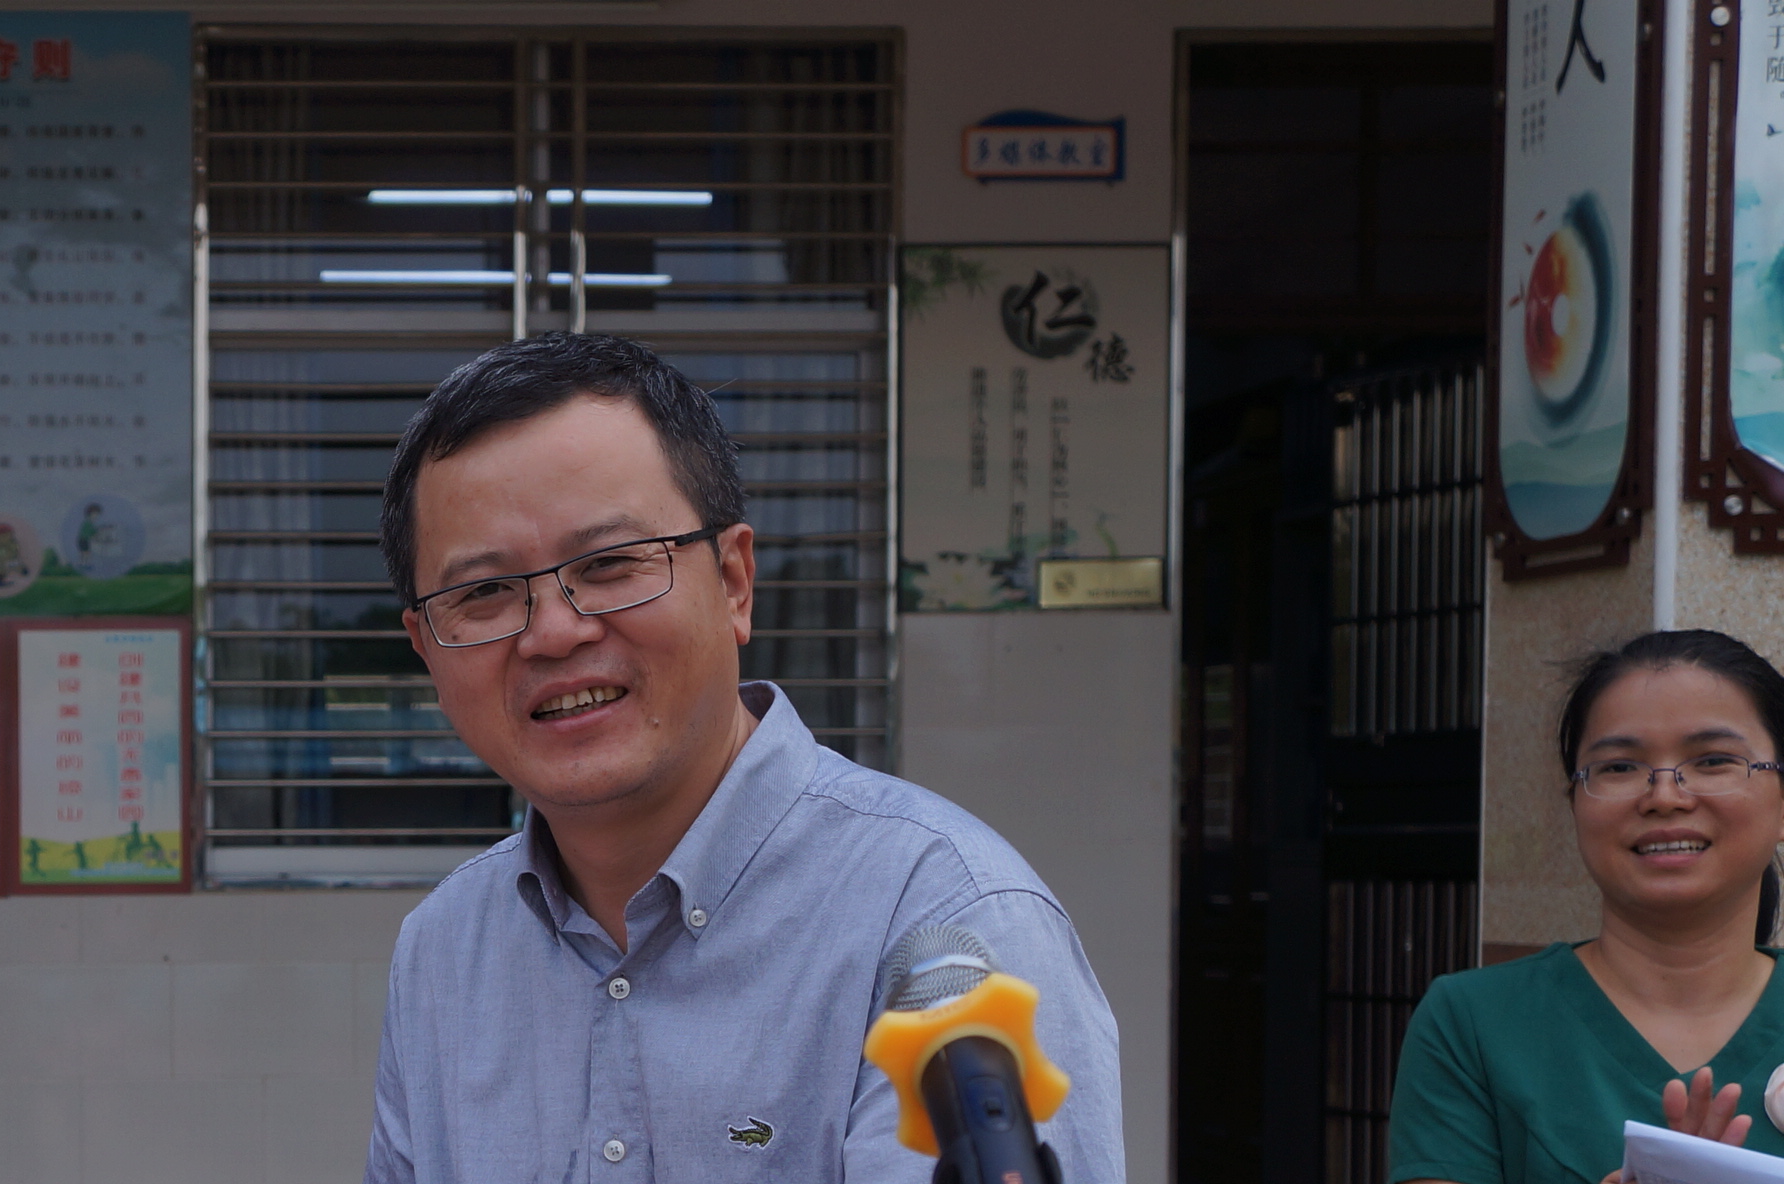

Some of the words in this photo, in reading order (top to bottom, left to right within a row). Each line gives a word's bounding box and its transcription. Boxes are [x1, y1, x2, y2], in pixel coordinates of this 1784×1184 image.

[974, 134, 1108, 168] 多媒体教室
